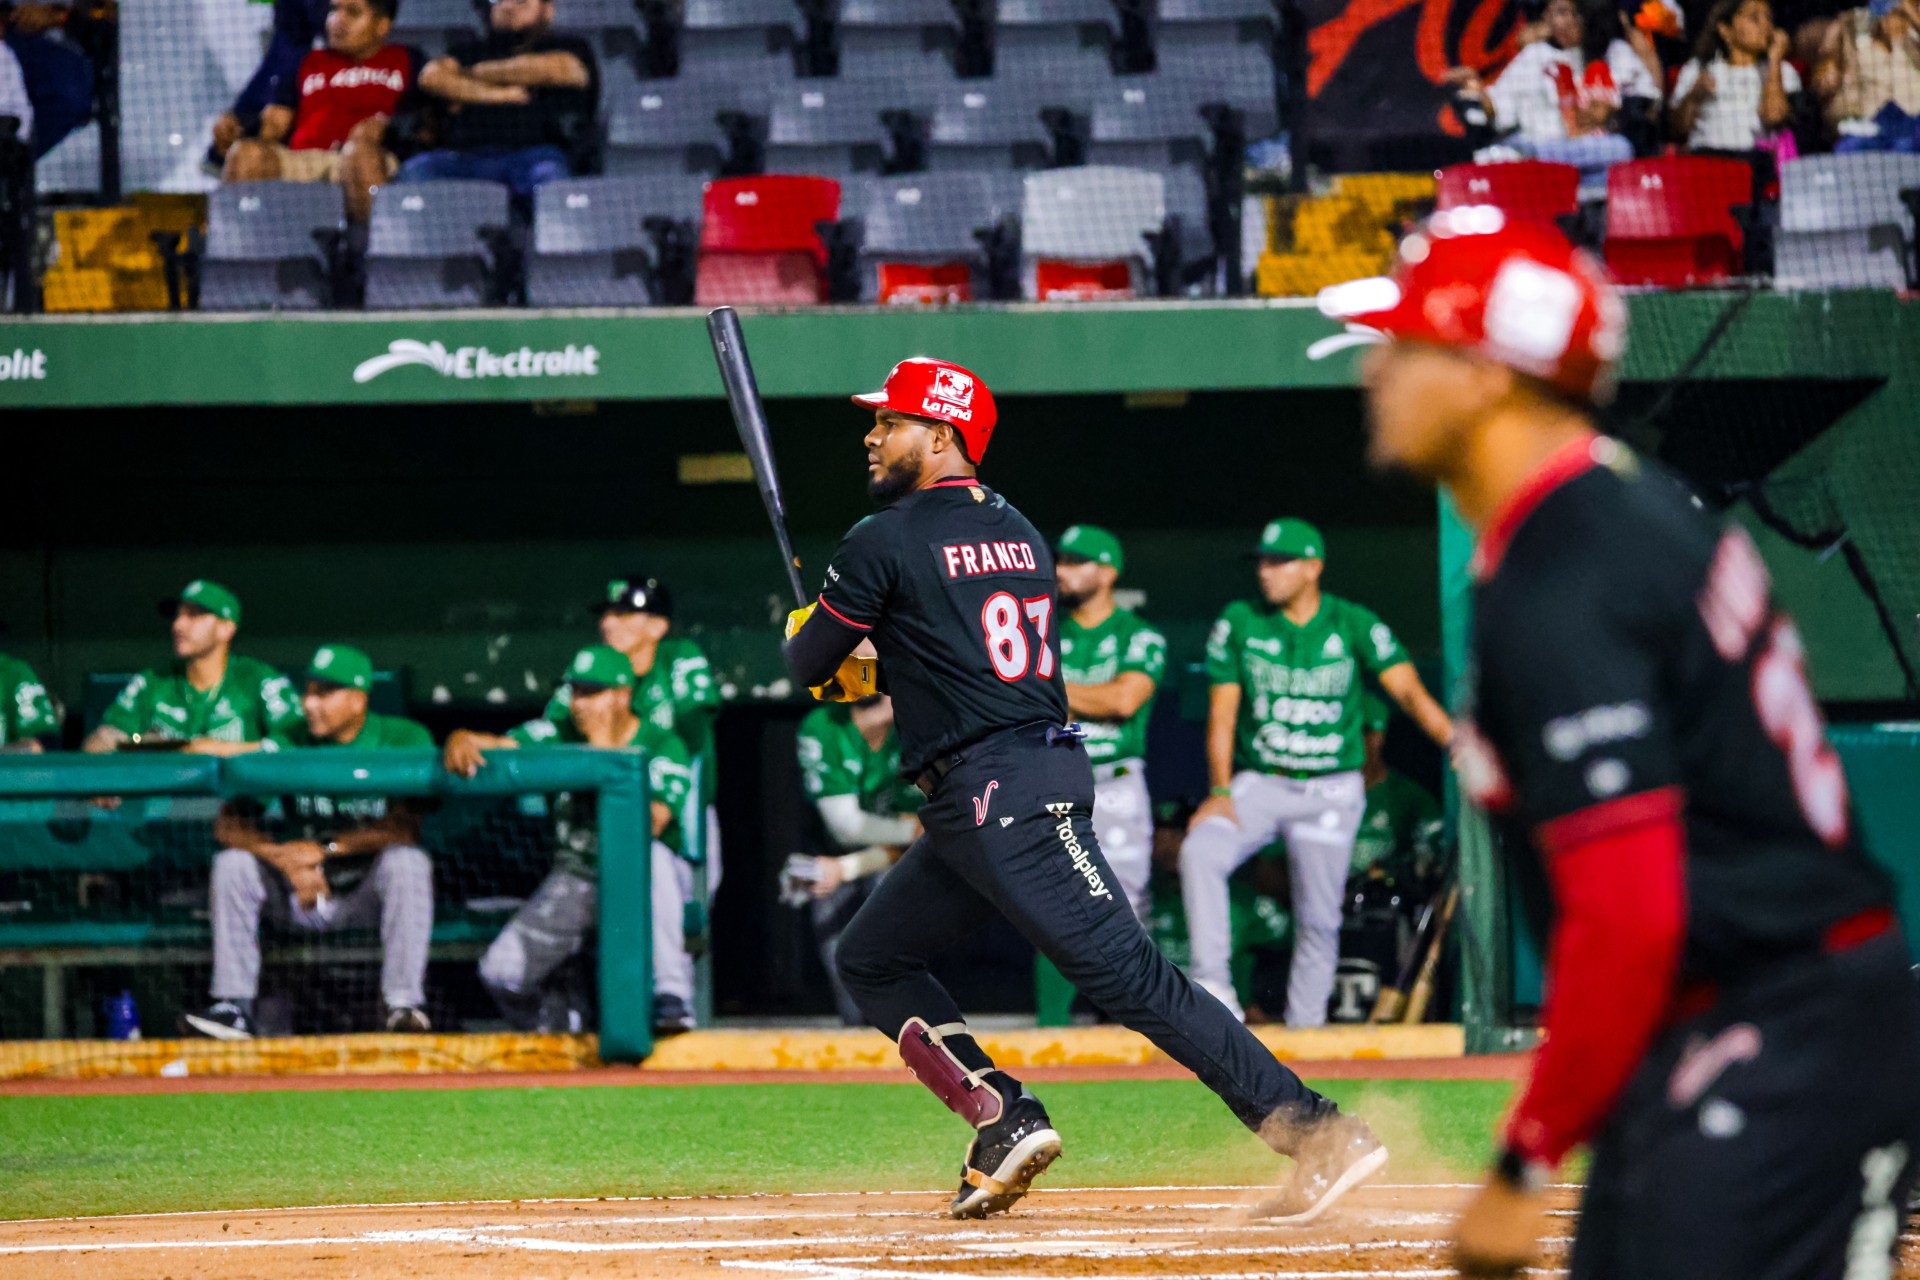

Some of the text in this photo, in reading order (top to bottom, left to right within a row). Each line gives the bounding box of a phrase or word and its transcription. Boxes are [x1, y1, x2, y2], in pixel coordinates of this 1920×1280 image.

[454, 344, 600, 379] Electrolit
[922, 398, 941, 412] La
[943, 541, 1037, 578] FRANCO
[981, 591, 1054, 682] 87
[1056, 817, 1109, 897] Totalplay
